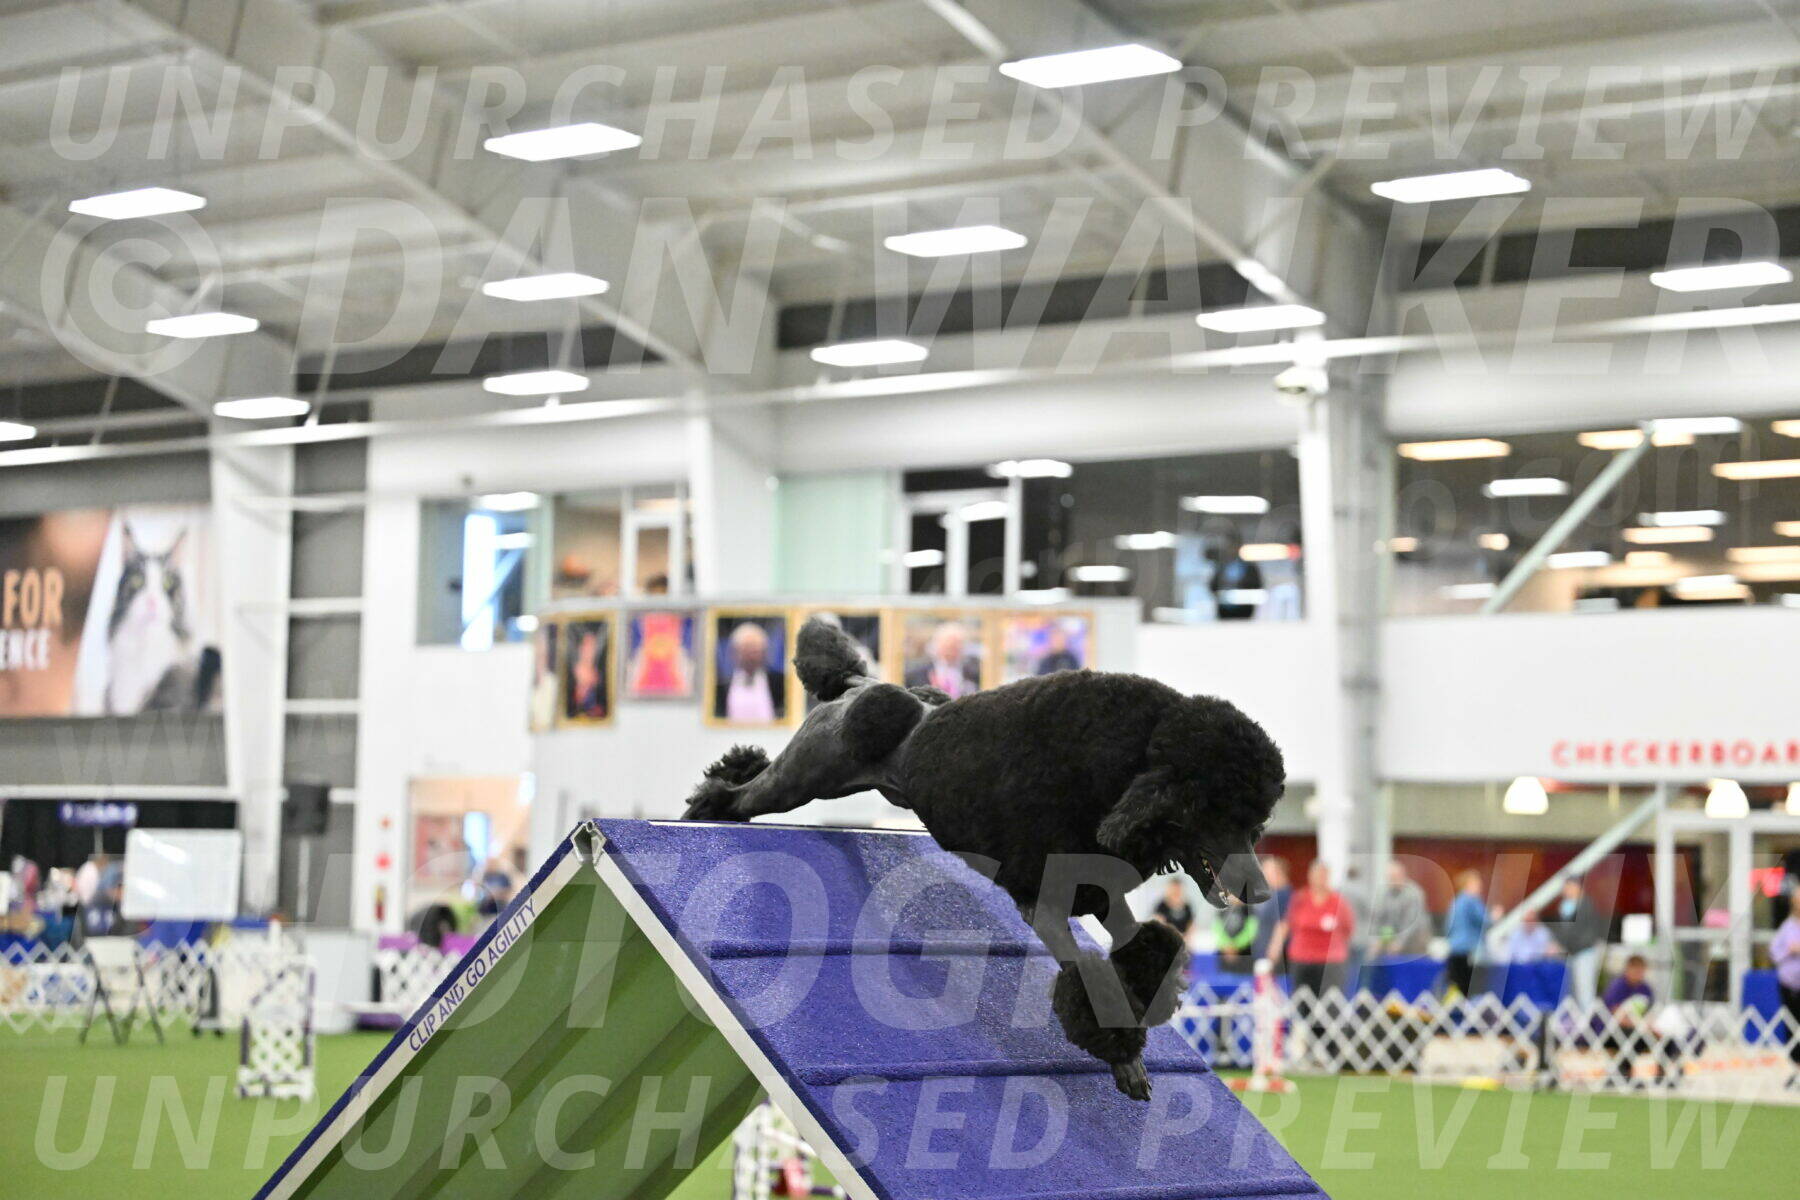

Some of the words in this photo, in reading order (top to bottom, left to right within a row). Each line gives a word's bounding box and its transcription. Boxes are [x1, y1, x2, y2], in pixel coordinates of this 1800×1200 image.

[3, 566, 64, 627] FOR
[409, 1013, 436, 1052] CLIP
[439, 984, 465, 1022] AND
[466, 958, 486, 987] GO
[488, 898, 536, 967] AGILITY
